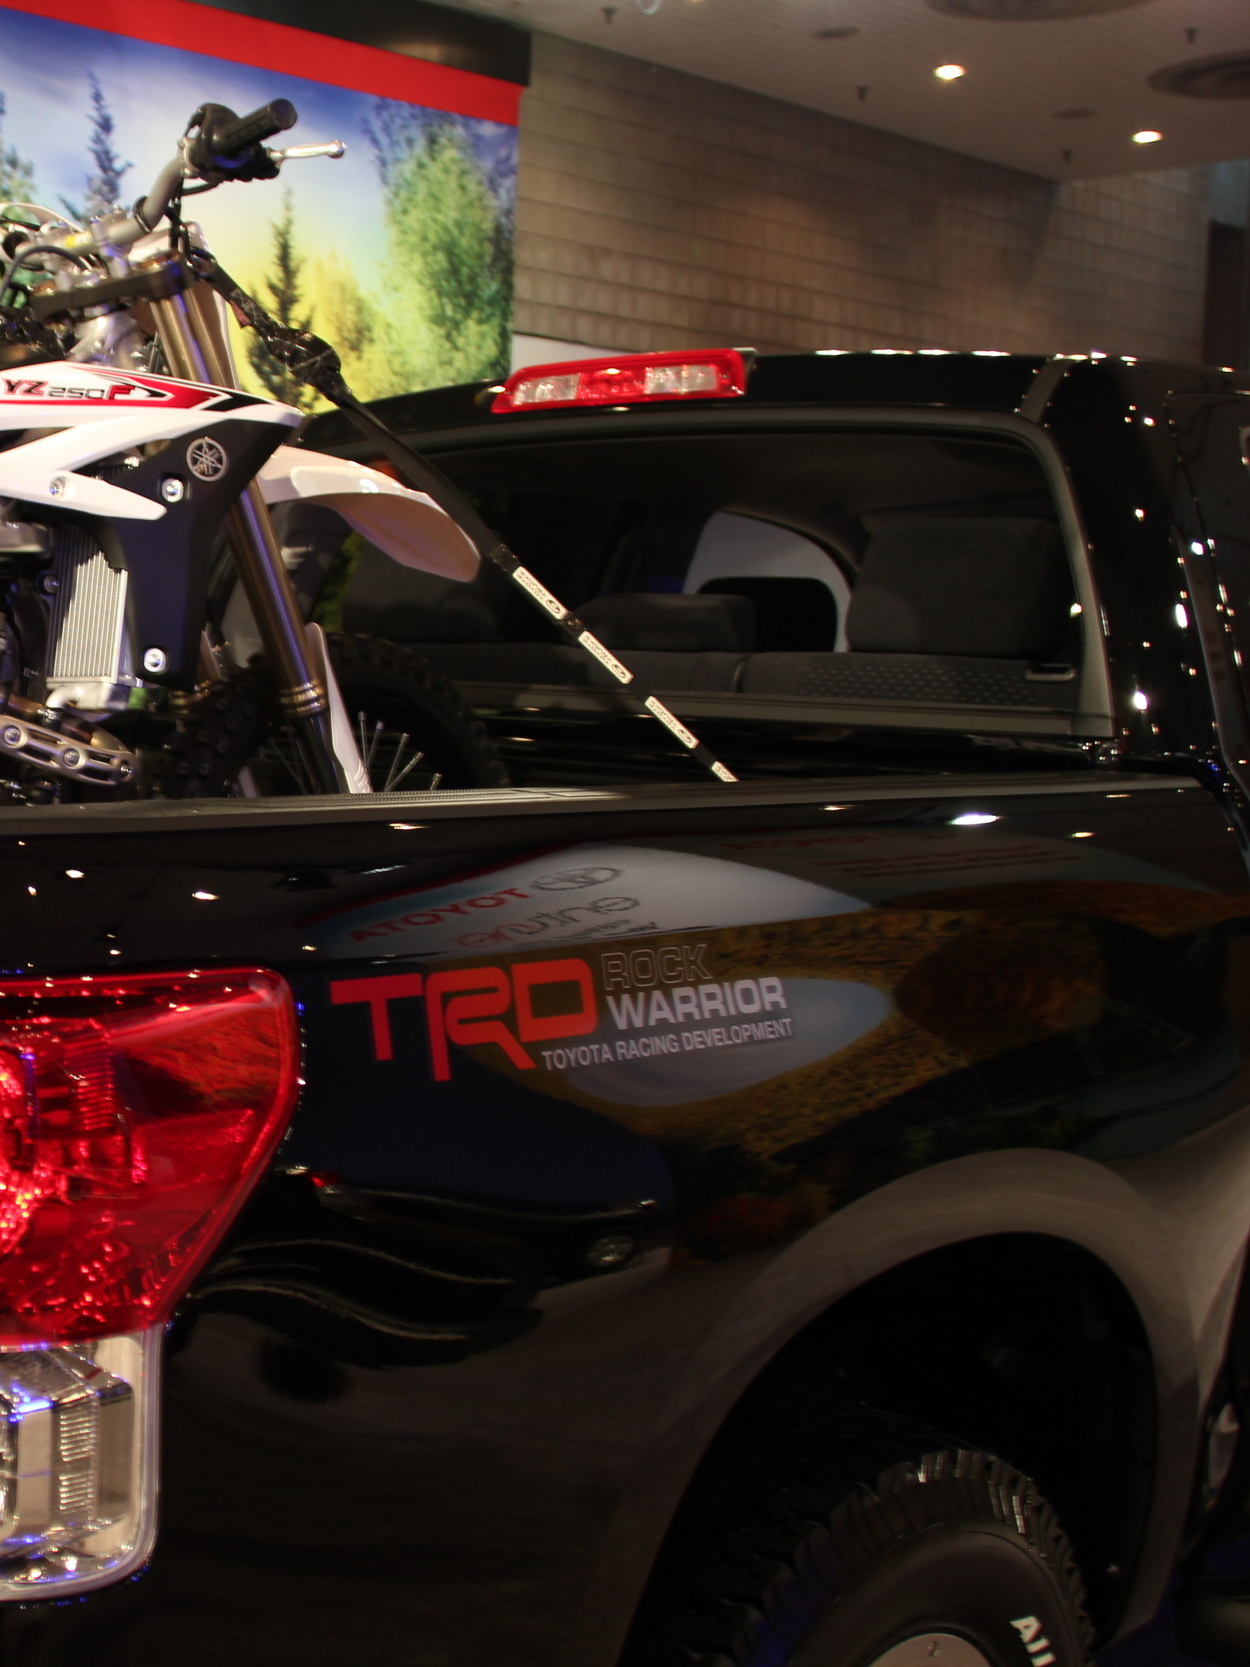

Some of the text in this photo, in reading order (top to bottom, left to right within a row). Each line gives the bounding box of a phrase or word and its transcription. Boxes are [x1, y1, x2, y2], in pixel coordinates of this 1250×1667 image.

[600, 943, 713, 991] ROCK
[329, 957, 598, 1082] TRD
[606, 976, 789, 1031] WARRIOR
[541, 1018, 793, 1071] TOYOTA RACING DEVELOPMENT
